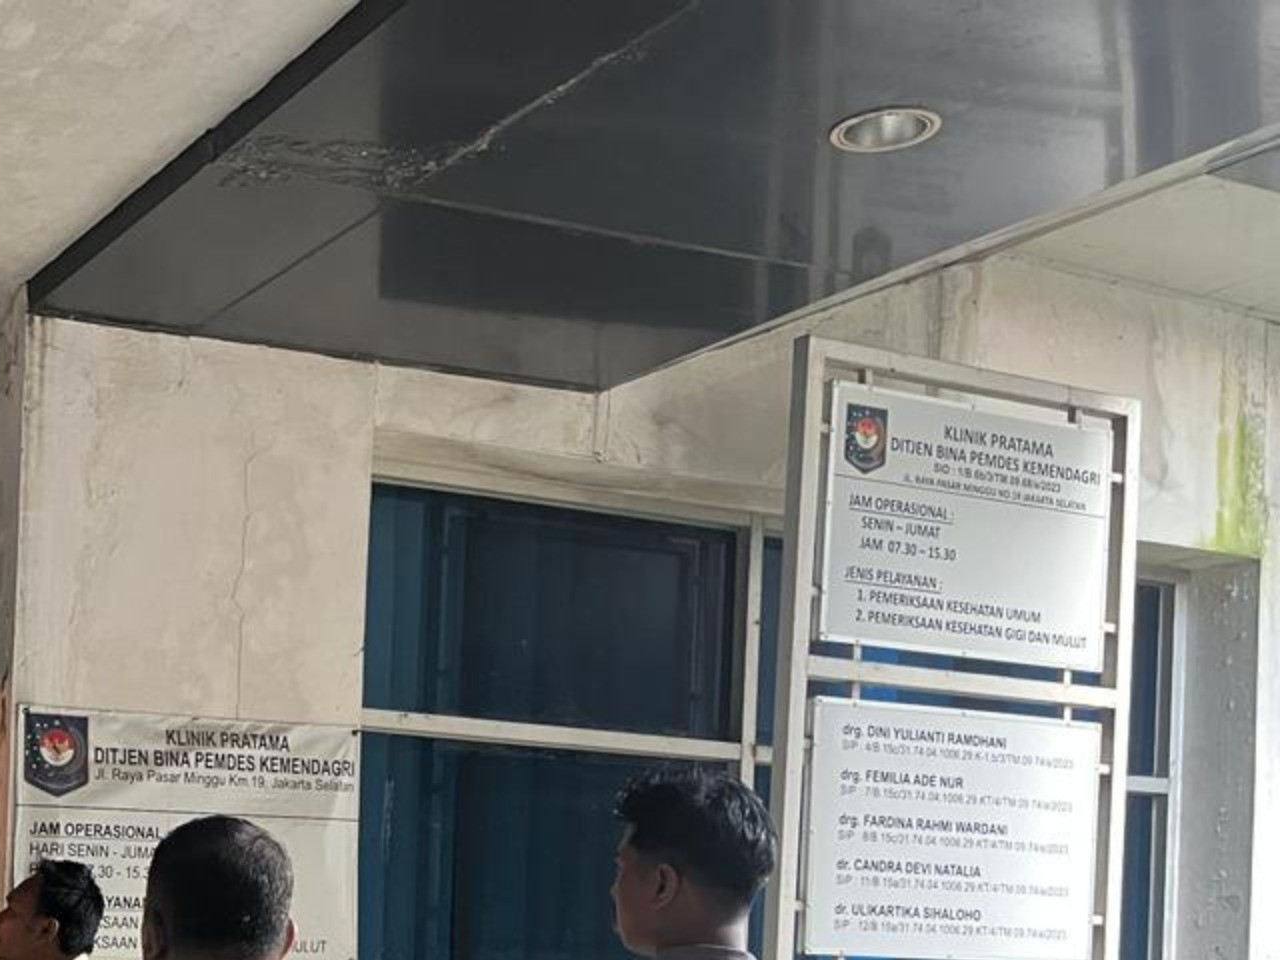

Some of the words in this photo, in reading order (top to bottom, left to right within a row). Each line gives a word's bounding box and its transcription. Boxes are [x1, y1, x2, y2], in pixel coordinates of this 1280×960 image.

[944, 425, 988, 446] KLINIK
[990, 434, 1054, 458] PRATAMA
[890, 437, 933, 458] DITJEN
[936, 445, 967, 463] BINA
[970, 450, 1020, 473] PEMDES
[1022, 461, 1101, 486] KEMENDAGRI
[849, 493, 872, 508] JAM
[874, 498, 948, 520] OPERASIONAL
[862, 516, 894, 532] SENIN
[905, 524, 941, 539] JUMAT
[859, 536, 883, 551] JAM
[887, 541, 917, 557] 07.30
[928, 546, 957, 562] 15.30
[845, 566, 874, 581] JENIS
[876, 568, 937, 590] PELAYANAN
[858, 590, 866, 602] 1.
[870, 590, 944, 612] PEMERIKSAAN
[946, 600, 1004, 618] KESEHATAN
[1006, 608, 1042, 622] UMUM
[856, 609, 866, 622] 2.
[868, 609, 942, 632] PEMERIKSAAN
[946, 620, 1002, 638] KESEHATAN
[1005, 628, 1026, 642] GIGI
[1028, 631, 1050, 644] DAN
[1052, 634, 1087, 649] MULUT
[165, 729, 218, 747] KLINIK
[220, 732, 290, 752] PRATAMA
[842, 724, 863, 738] drg.
[867, 725, 890, 739] DINI
[893, 728, 945, 744] YULIANTI
[948, 732, 1008, 750] RAMDHANI
[94, 747, 149, 766] DITJEN
[153, 750, 191, 768] BINA
[194, 752, 255, 772] PEMDES
[259, 757, 355, 778] KEMENDAGRI
[112, 769, 143, 784] Raya
[147, 770, 181, 783] Pasar
[184, 773, 226, 788] Minggu
[270, 777, 312, 790] Jakarta
[316, 780, 354, 792] Selatan
[840, 769, 863, 783] drg.
[865, 770, 910, 784] FEMILIA
[913, 774, 936, 788] ADE
[939, 776, 964, 789] NUR
[30, 822, 60, 836] JAM
[64, 823, 162, 840] OPERASIONAL
[838, 814, 859, 828] drg.
[863, 814, 914, 829] FARDINA
[916, 818, 953, 832] RAHMI
[955, 820, 1008, 835] WARDANI
[30, 842, 64, 857] HARI
[68, 844, 110, 858] SENIN
[120, 845, 157, 860] JUMA
[836, 858, 852, 872] dr.
[854, 858, 902, 874] CANDRA
[905, 862, 932, 875] DEVI
[934, 864, 982, 878] NATALIA
[834, 902, 850, 916] dr.
[852, 905, 920, 919] ULIKARTIKA
[924, 908, 982, 922] SIHALOHO
